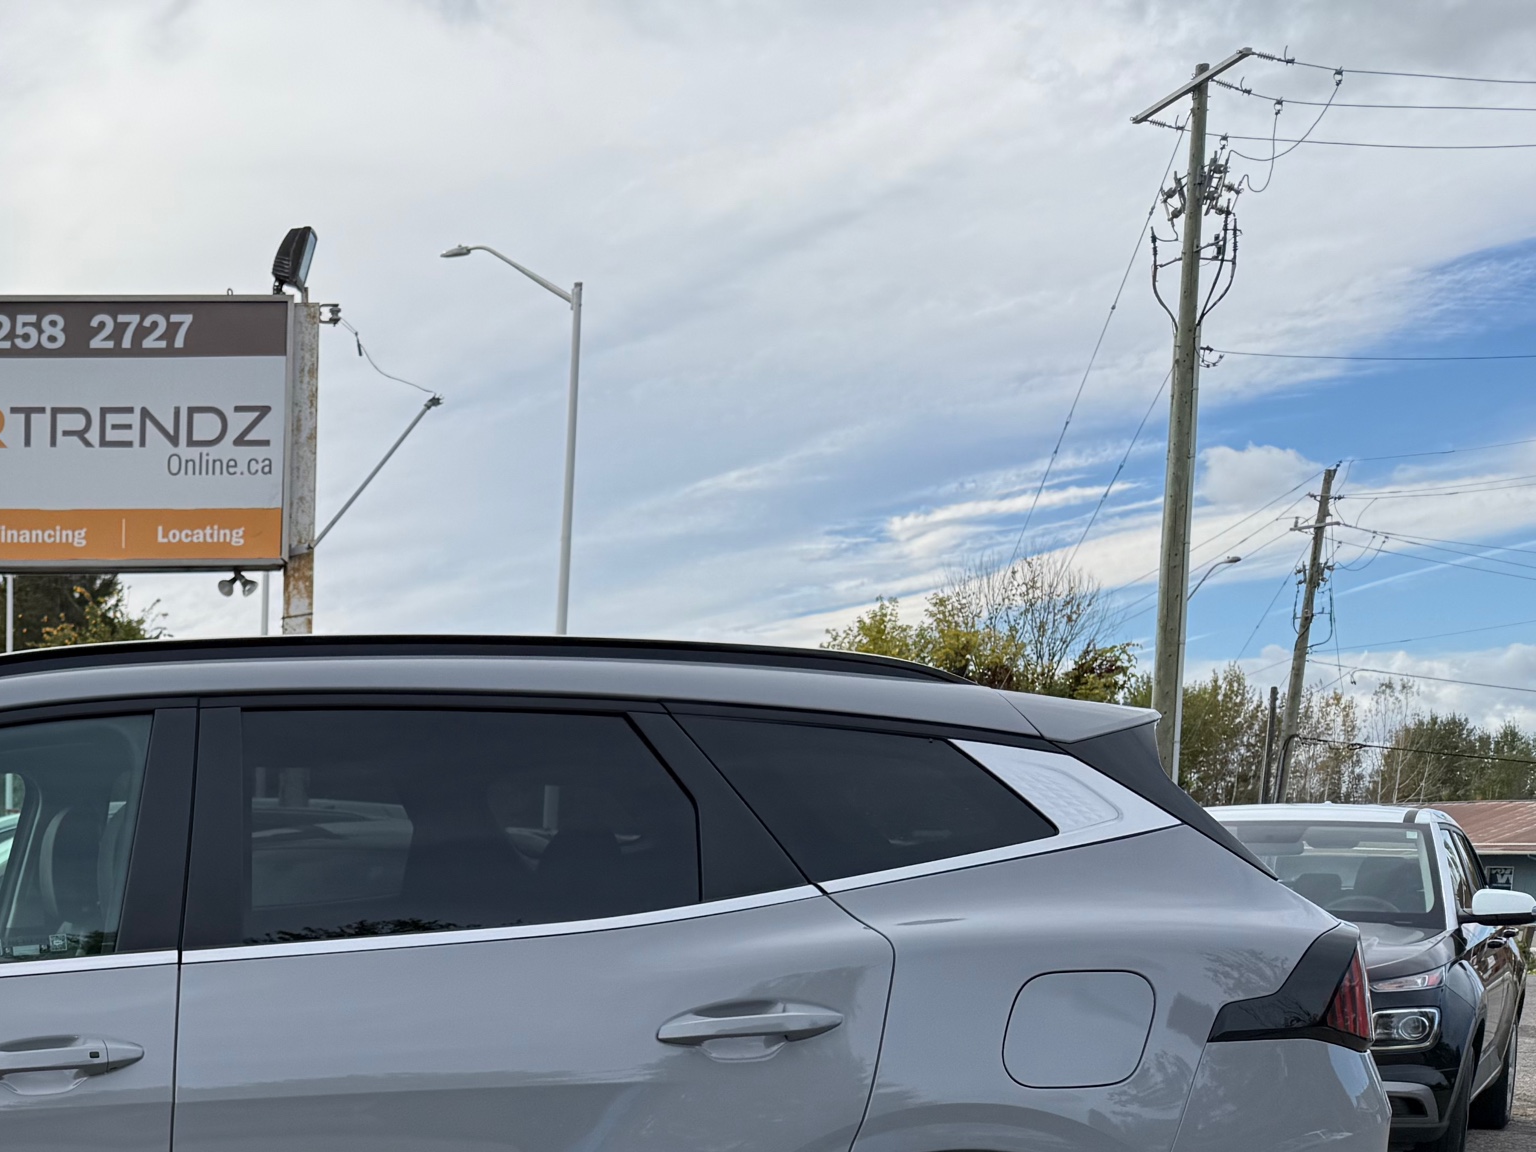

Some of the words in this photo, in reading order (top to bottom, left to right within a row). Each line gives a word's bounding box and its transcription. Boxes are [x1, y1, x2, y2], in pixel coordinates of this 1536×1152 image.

[89, 313, 194, 349] 2727
[166, 452, 273, 476] Online.ca
[156, 525, 245, 547] Locating
